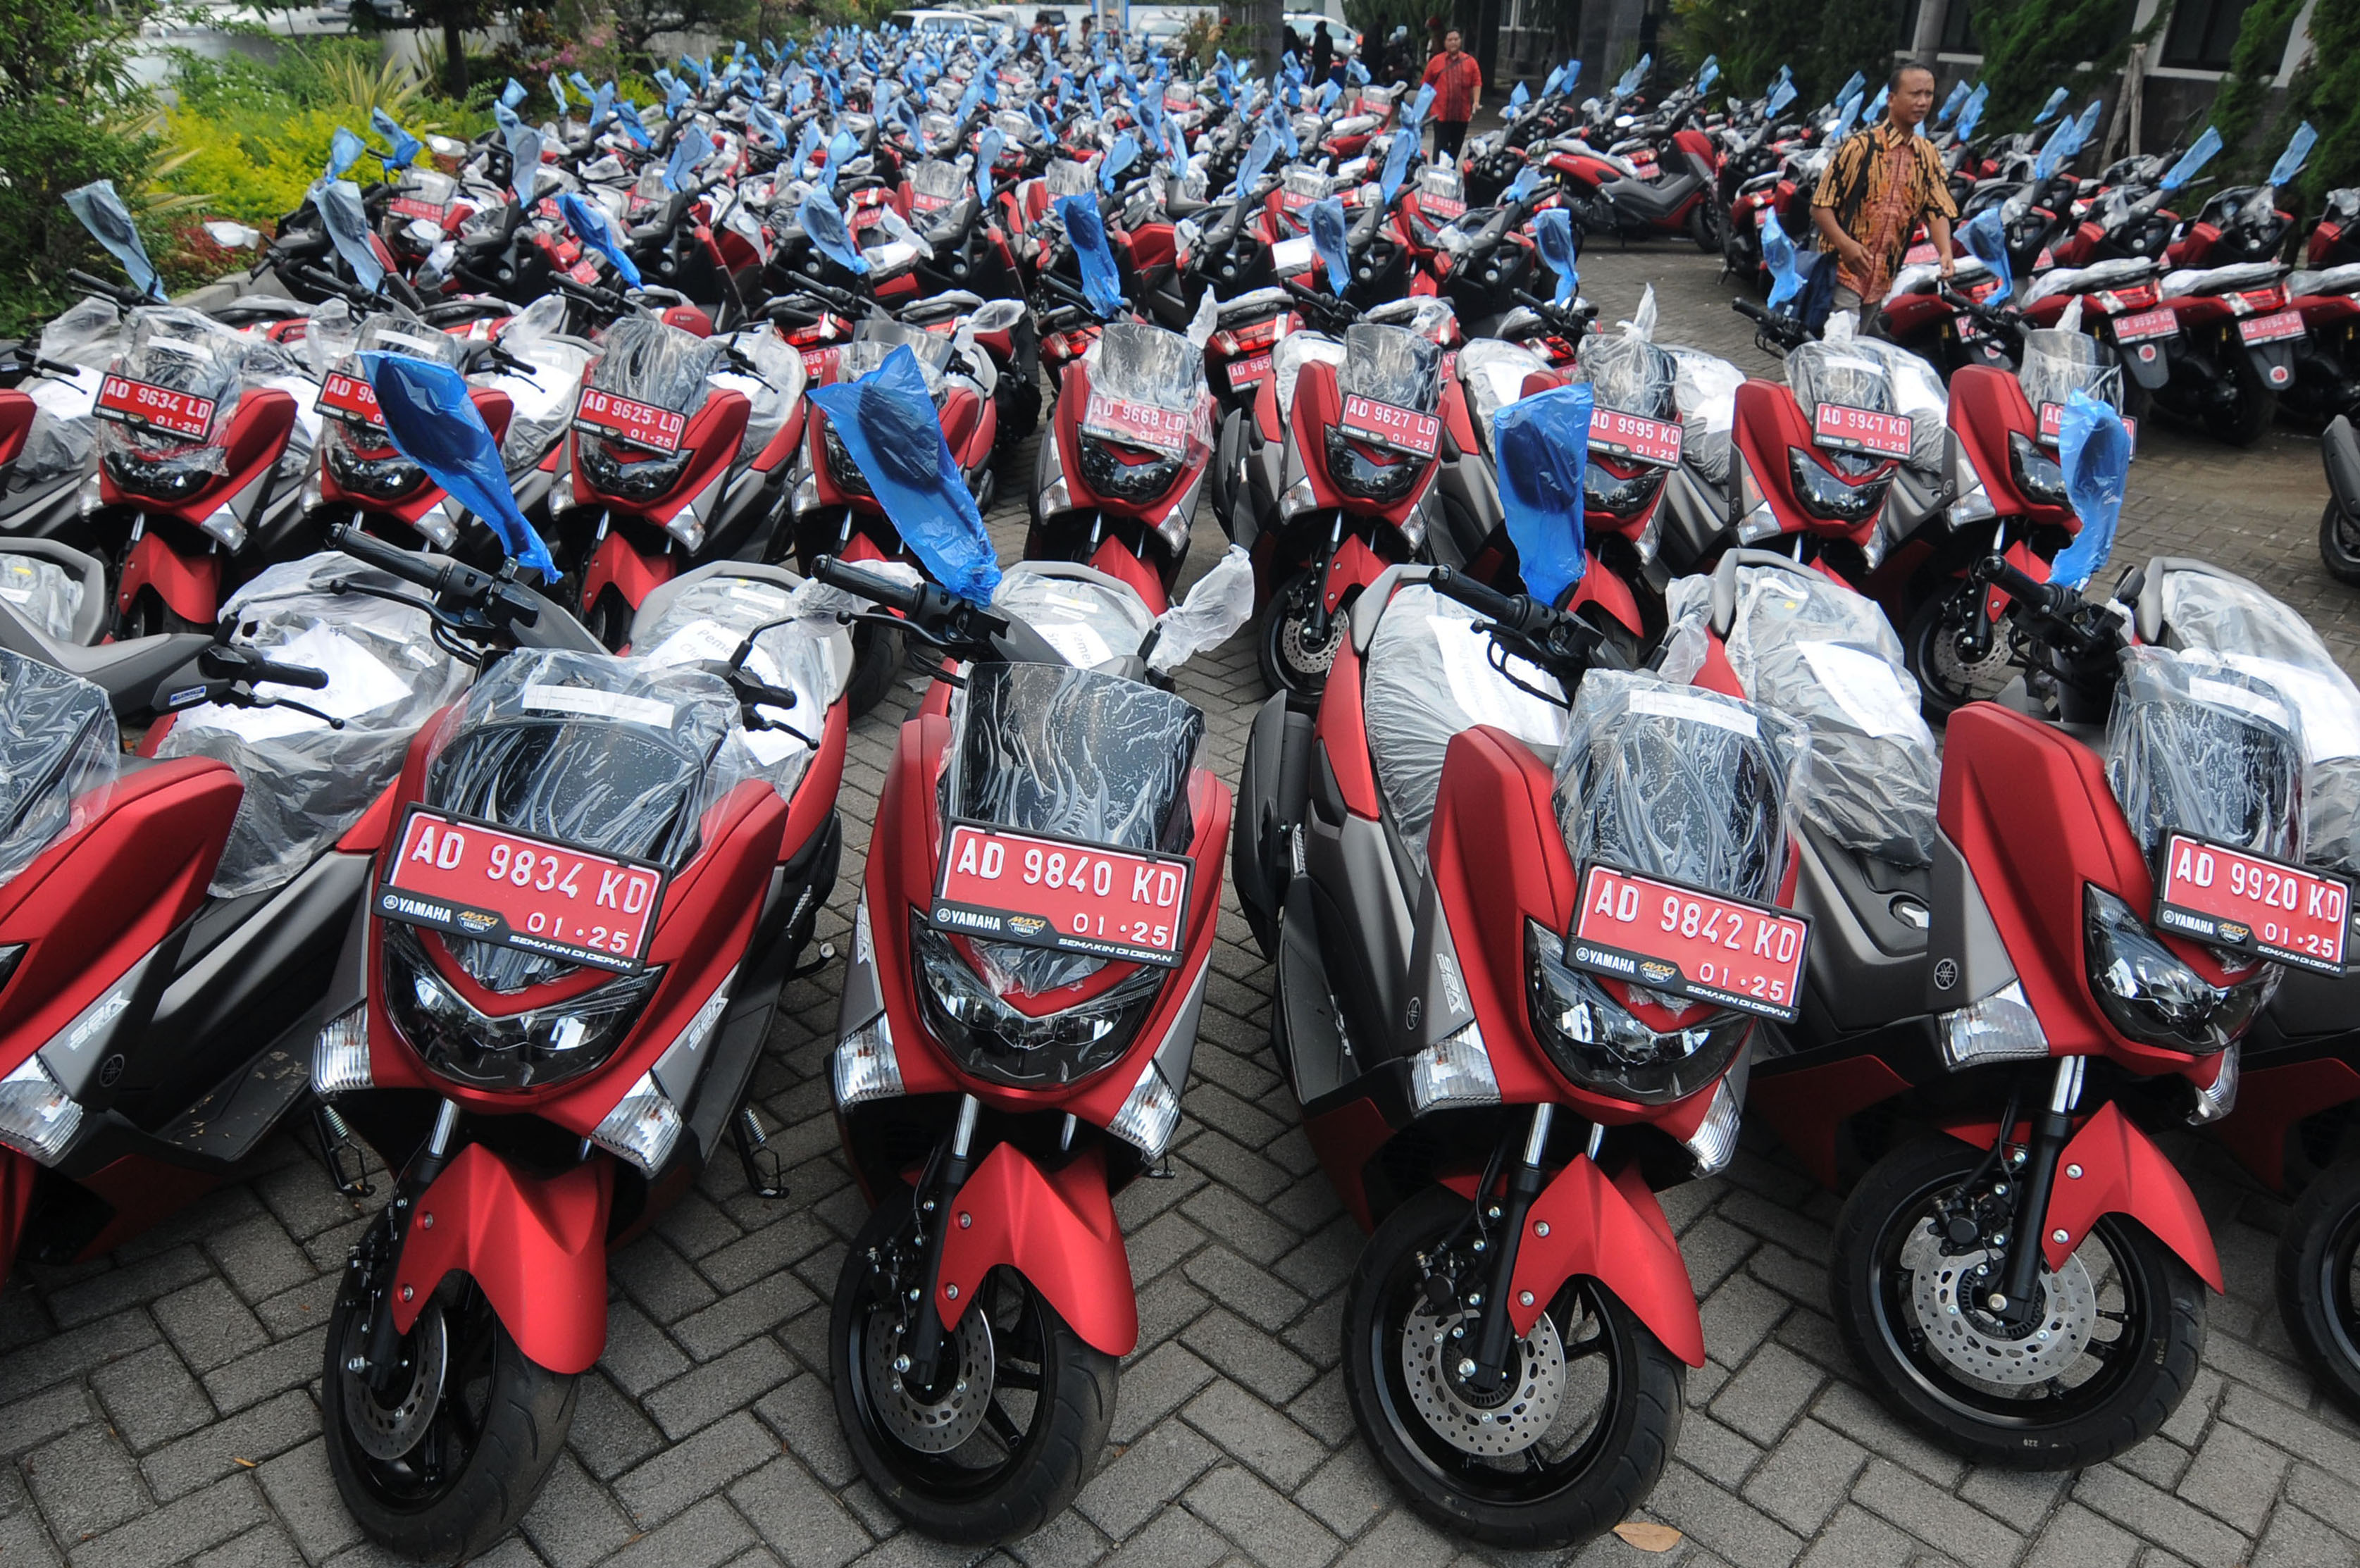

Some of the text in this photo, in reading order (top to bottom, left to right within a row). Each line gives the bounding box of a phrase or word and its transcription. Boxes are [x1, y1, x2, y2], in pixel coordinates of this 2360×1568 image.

[801, 352, 822, 366] 896
[1232, 364, 1246, 378] AD
[106, 380, 209, 419] AD 9634 LD
[328, 378, 377, 404] AD 96
[585, 392, 681, 433] AD 9625 LD
[1093, 399, 1113, 417] AD
[1165, 413, 1184, 431] LD
[1348, 399, 1435, 435] AD 9627 LD
[1822, 409, 1908, 437] AD 9947 KD
[1590, 411, 1679, 445] AD 9995 KD
[411, 826, 647, 914] AD 9834 KD
[957, 838, 1177, 907] AD 9840 KD
[2175, 847, 2341, 922] AD 9920 KD
[398, 897, 451, 923] YAMAHA
[459, 910, 498, 926] MAXI
[952, 911, 1000, 931] YAMAHA
[1011, 916, 1045, 928] MAXI
[1595, 880, 1796, 963] AD 9842 KD
[2174, 914, 2213, 935] YAMAHA
[509, 935, 570, 954] SEMAKIN
[585, 953, 632, 969] DEPAN
[1059, 938, 1115, 953] SEMAKIN
[1129, 950, 1172, 962] DEPAN
[1589, 950, 1634, 973] YAMAHA
[1641, 962, 1677, 975] MAXI
[1687, 985, 1739, 1004] SEMAKIN
[1752, 1004, 1790, 1019] DEPAN
